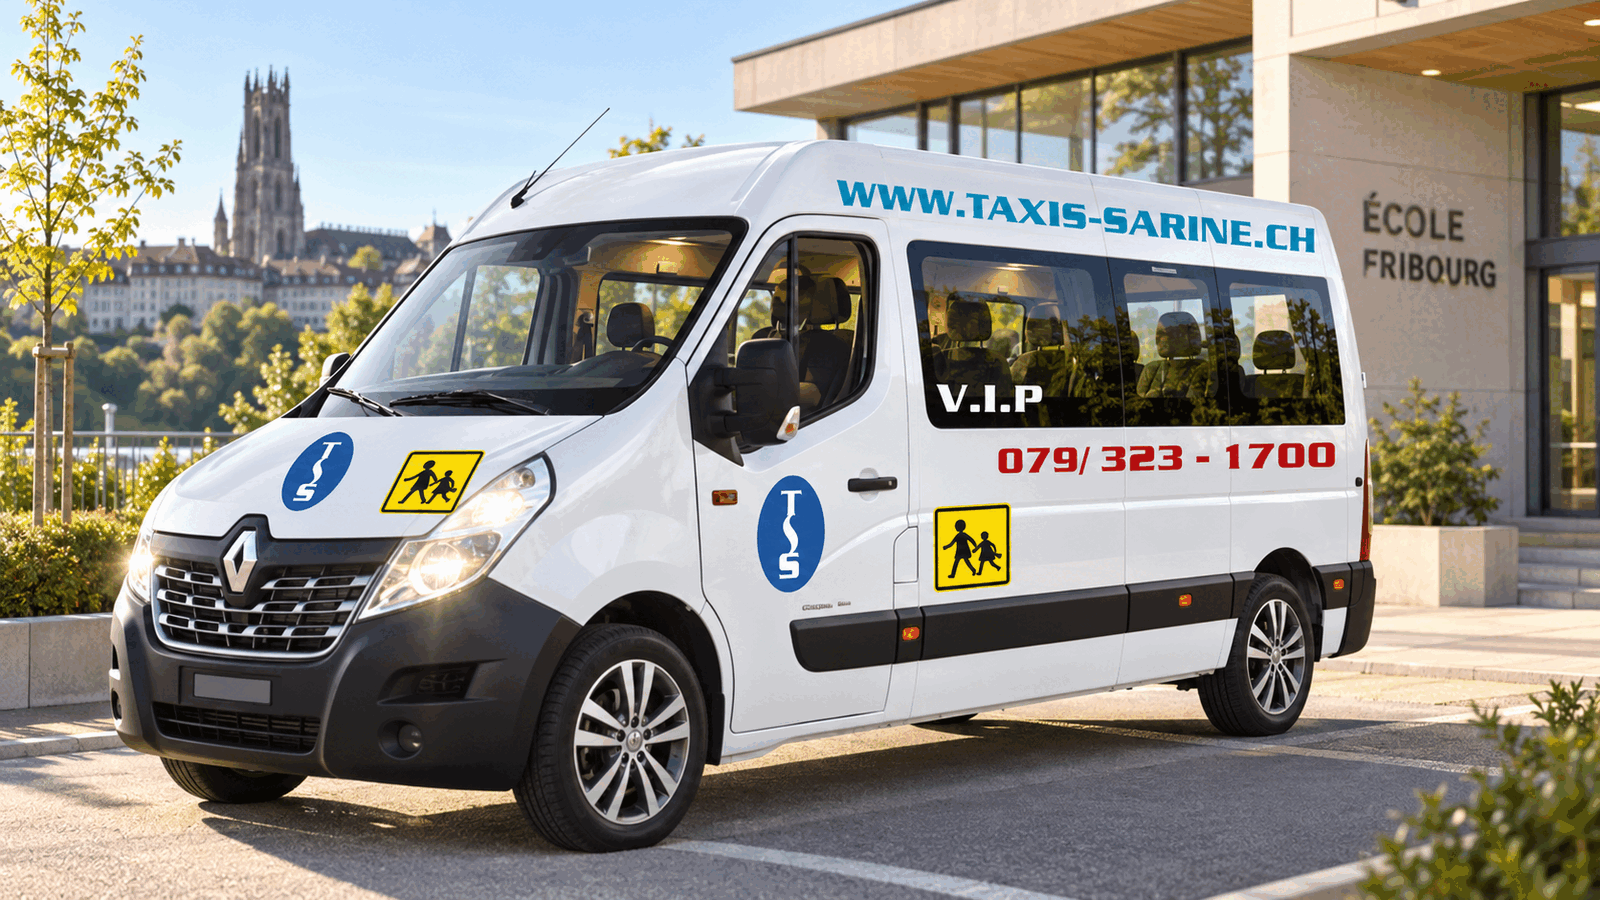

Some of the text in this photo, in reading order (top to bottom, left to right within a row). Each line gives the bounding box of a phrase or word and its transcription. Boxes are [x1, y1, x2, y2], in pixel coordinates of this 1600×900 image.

[836, 179, 1316, 254] WWW.TAXIS-SARINE.CH
[1363, 191, 1465, 243] ÉCOLE
[1363, 248, 1497, 289] FRIBOURG
[936, 384, 1043, 413] V.I.P
[1102, 445, 1183, 472] 323
[1225, 441, 1336, 470] 1700
